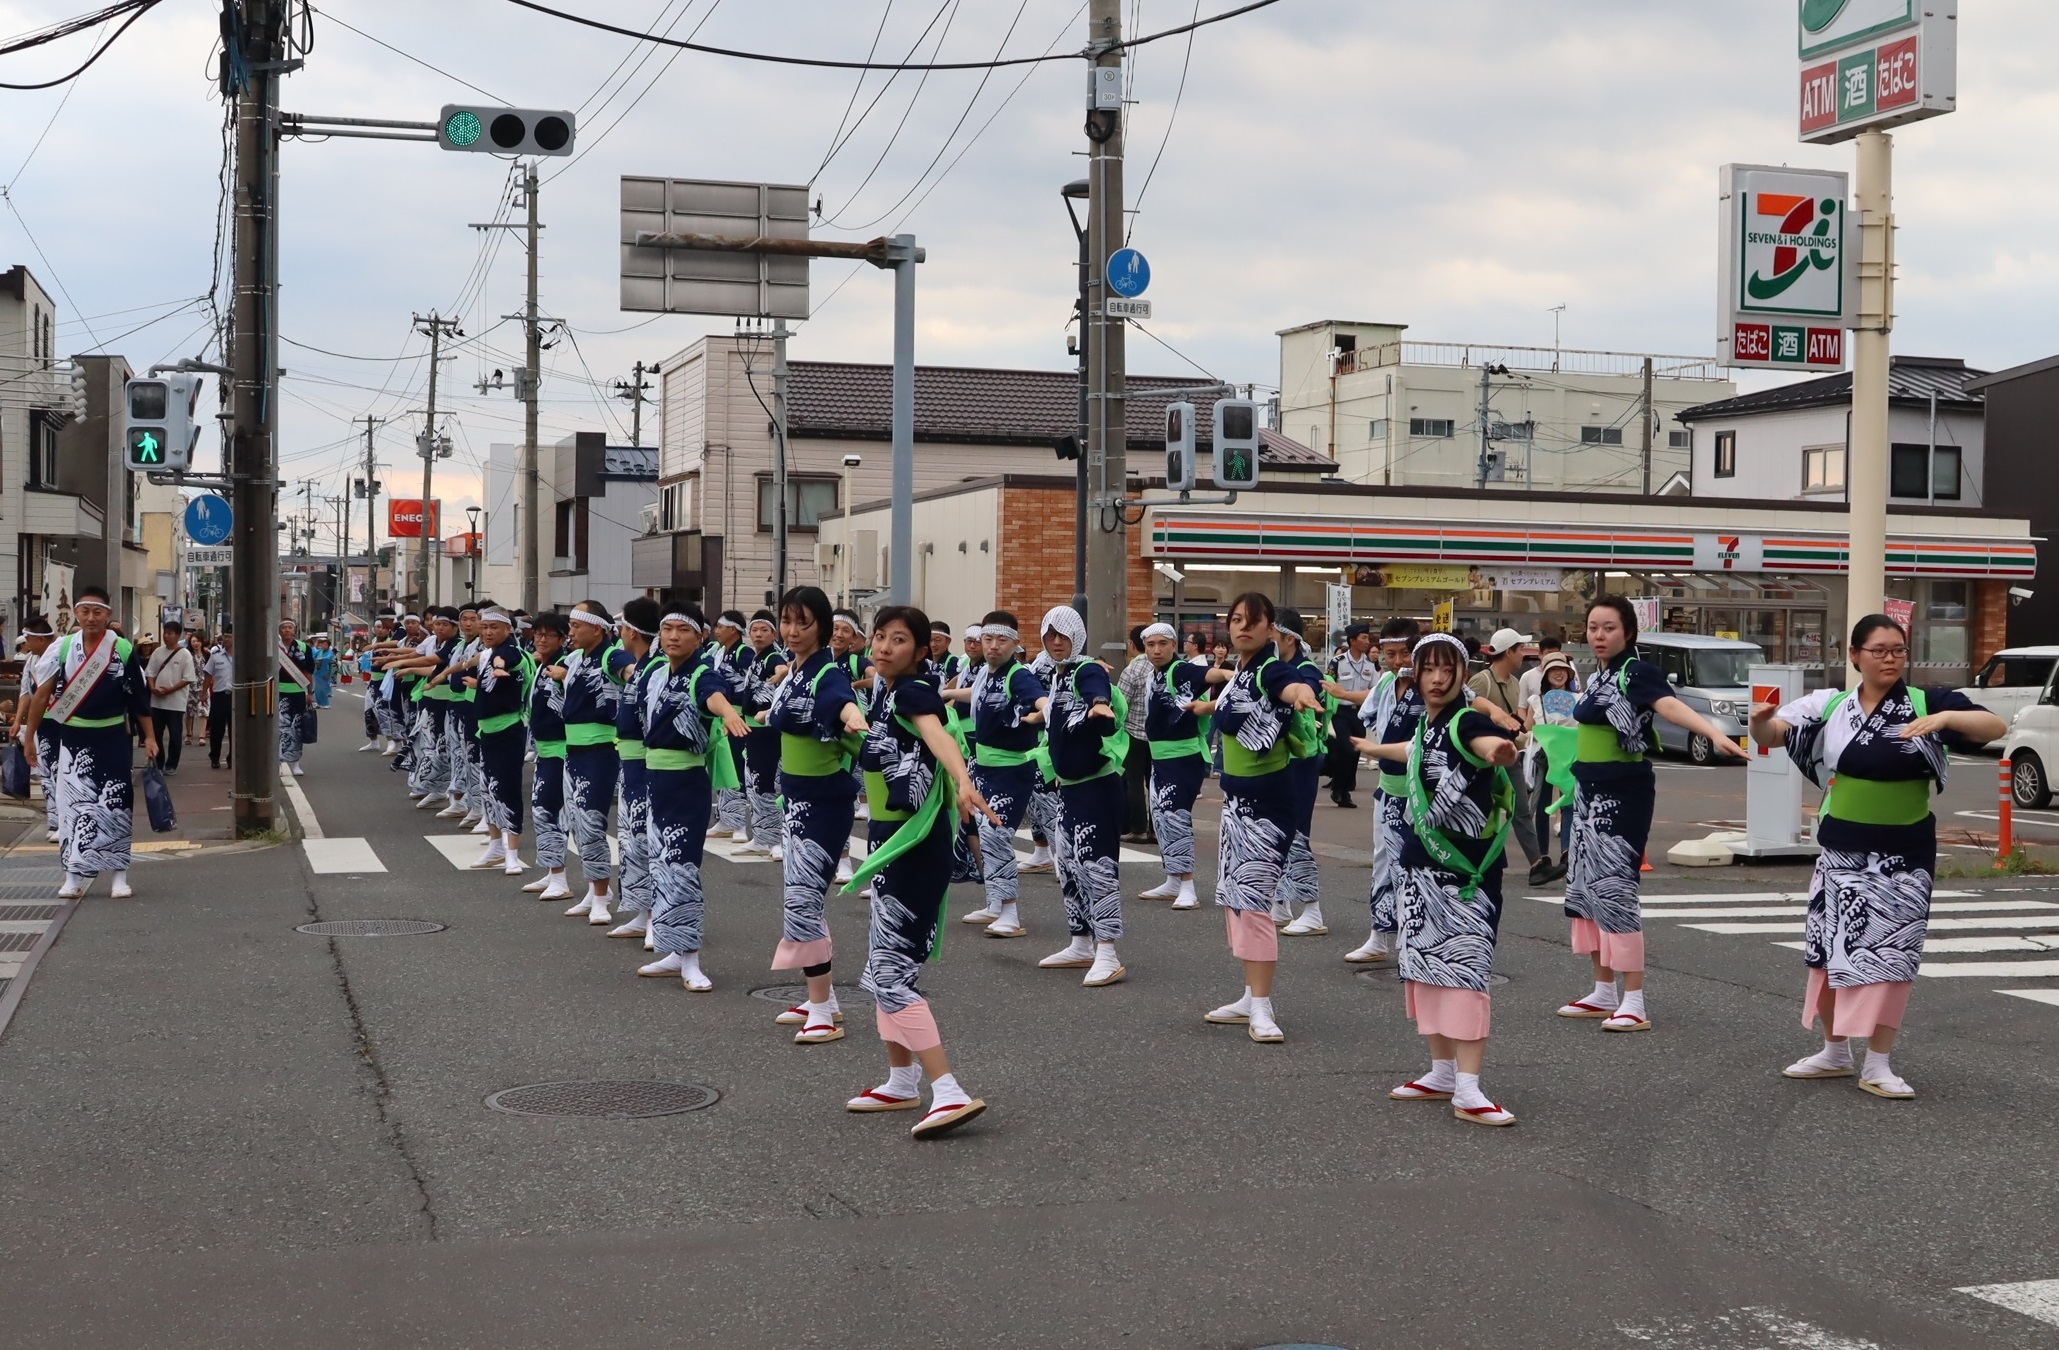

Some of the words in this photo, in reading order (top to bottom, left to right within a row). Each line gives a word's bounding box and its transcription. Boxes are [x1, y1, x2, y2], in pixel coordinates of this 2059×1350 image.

[1845, 64, 1868, 109] 酒
[1878, 51, 1914, 99] たばこ
[1803, 74, 1835, 120] ATM
[1789, 235, 1837, 249] HOLDINGS
[1110, 302, 1149, 314] 自転車通行可
[1736, 330, 1768, 354] たばこ
[1778, 331, 1799, 357] 酒
[1809, 334, 1839, 359] ATM
[394, 513, 424, 523] ENEO
[187, 551, 232, 563] 自転車通行可
[1395, 574, 1467, 583] セブンプレミアムゴールド
